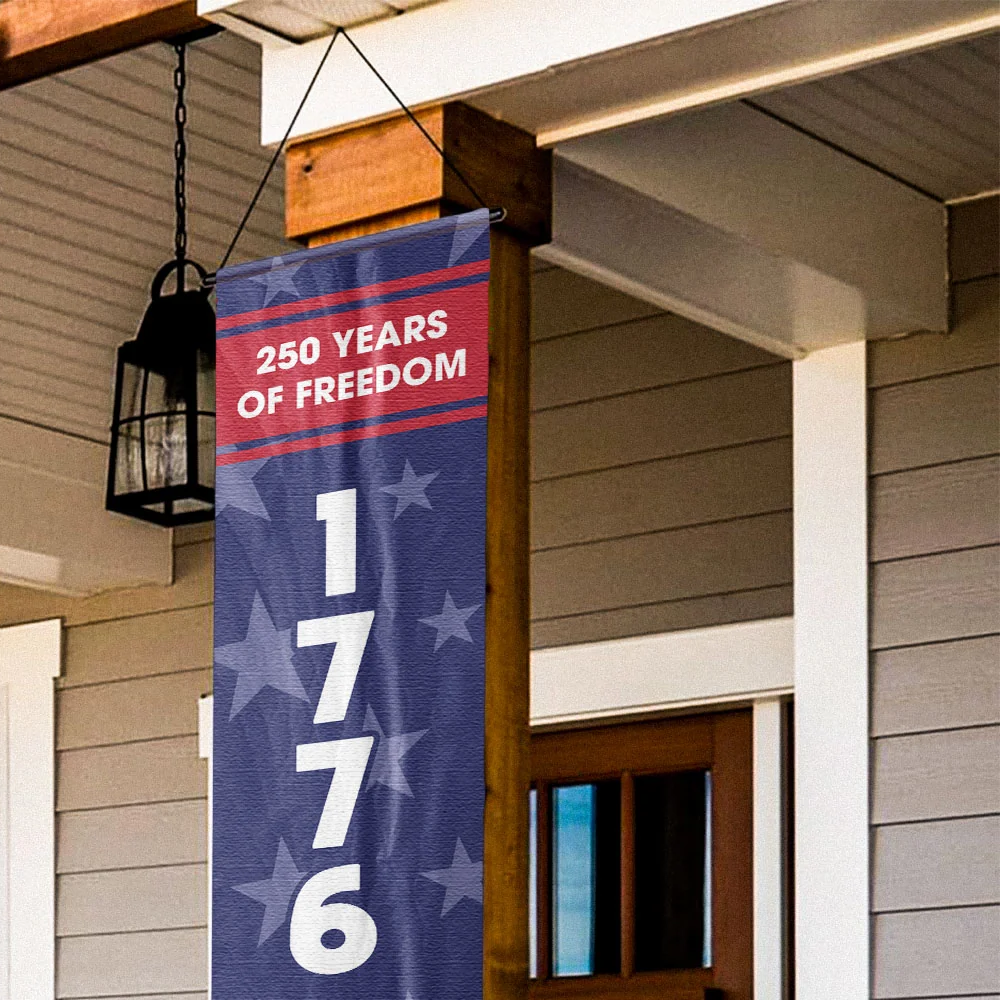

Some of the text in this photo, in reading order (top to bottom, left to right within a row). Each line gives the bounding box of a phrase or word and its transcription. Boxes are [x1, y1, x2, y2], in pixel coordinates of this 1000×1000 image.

[256, 309, 448, 376] 250 YEARS
[237, 348, 467, 419] OF FREEDOM
